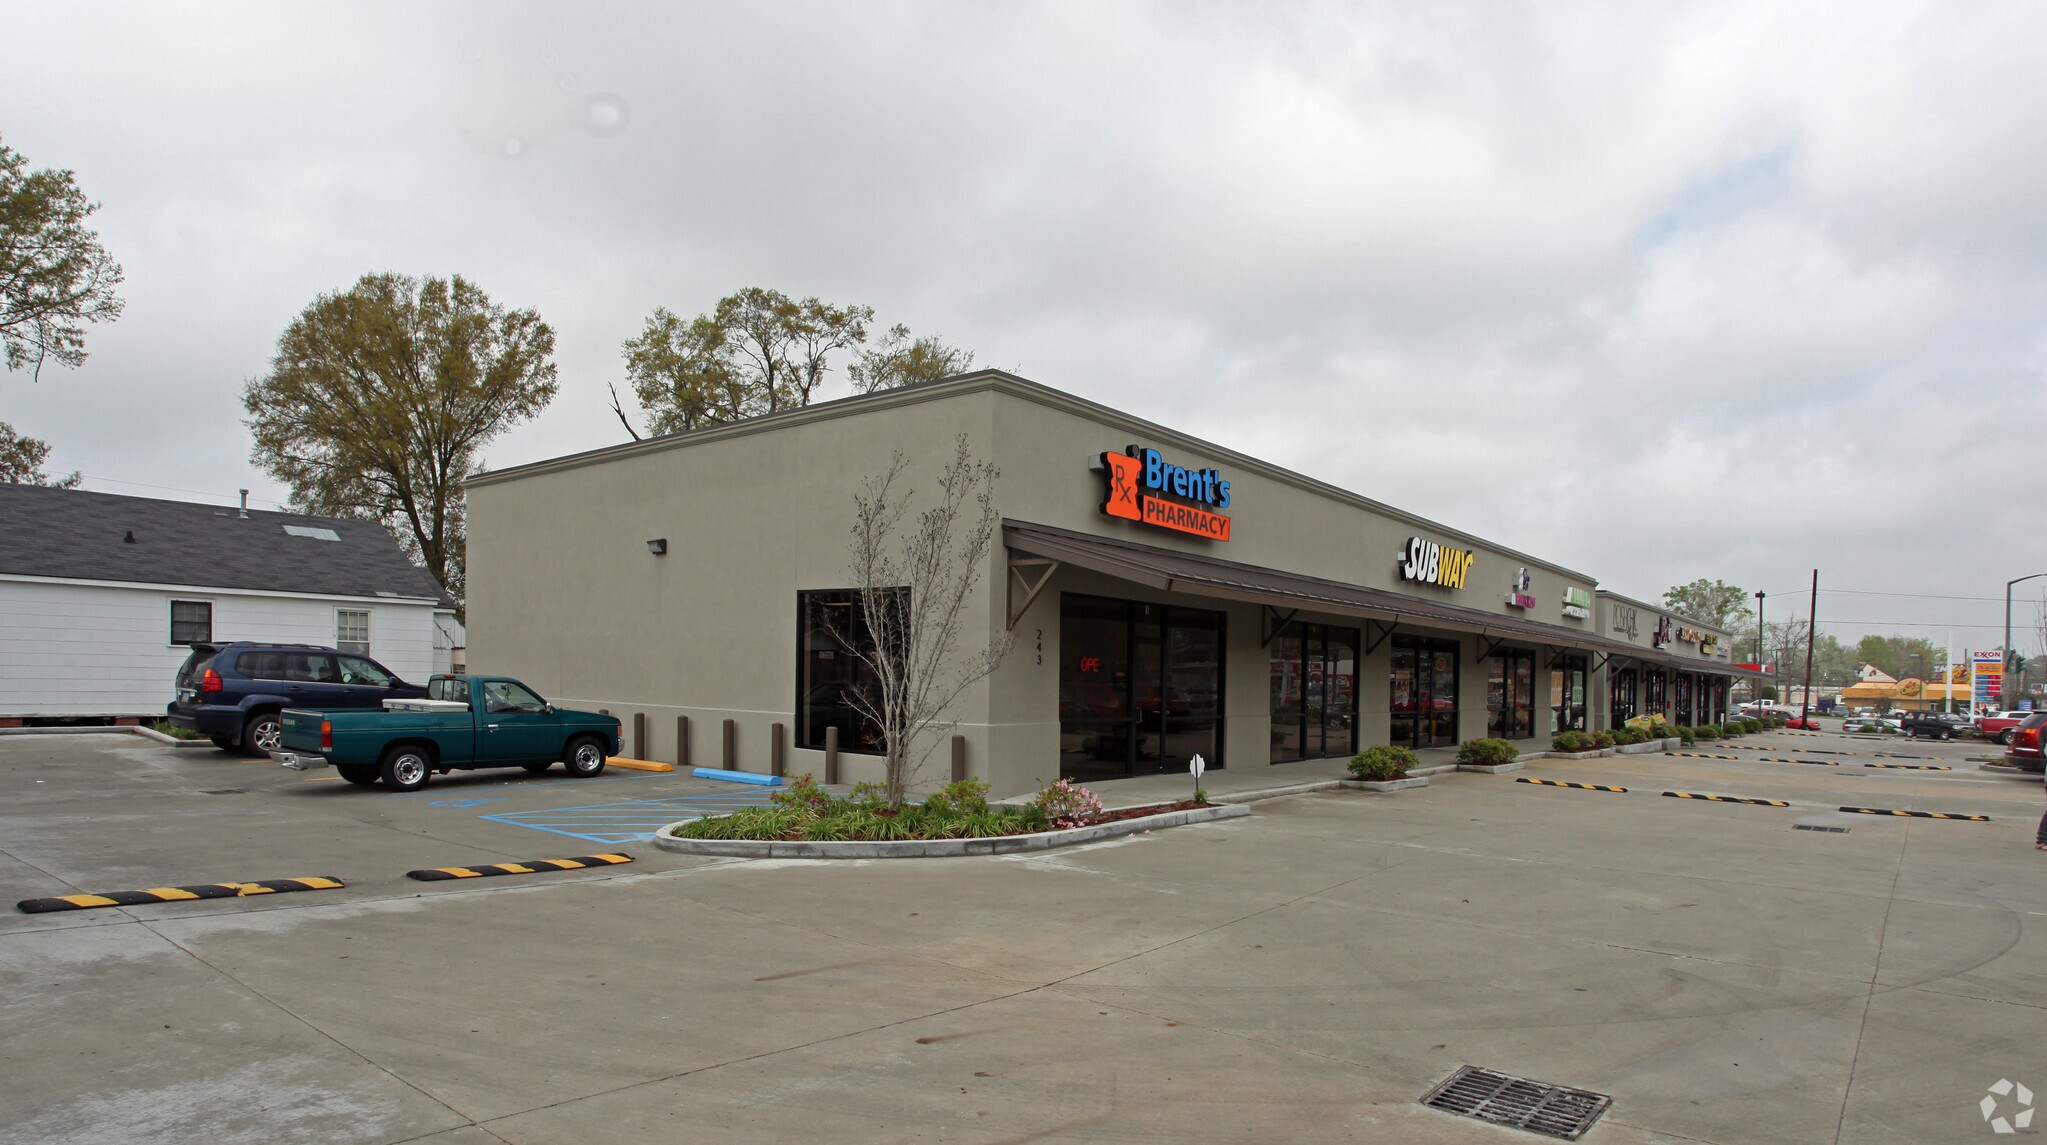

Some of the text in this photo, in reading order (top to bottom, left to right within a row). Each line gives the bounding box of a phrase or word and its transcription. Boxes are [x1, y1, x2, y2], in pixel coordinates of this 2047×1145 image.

[1145, 448, 1231, 509] Brent's
[1146, 500, 1227, 536] PHARMACY
[1403, 536, 1474, 590] SUBWAY
[1973, 651, 2001, 659] EXXON
